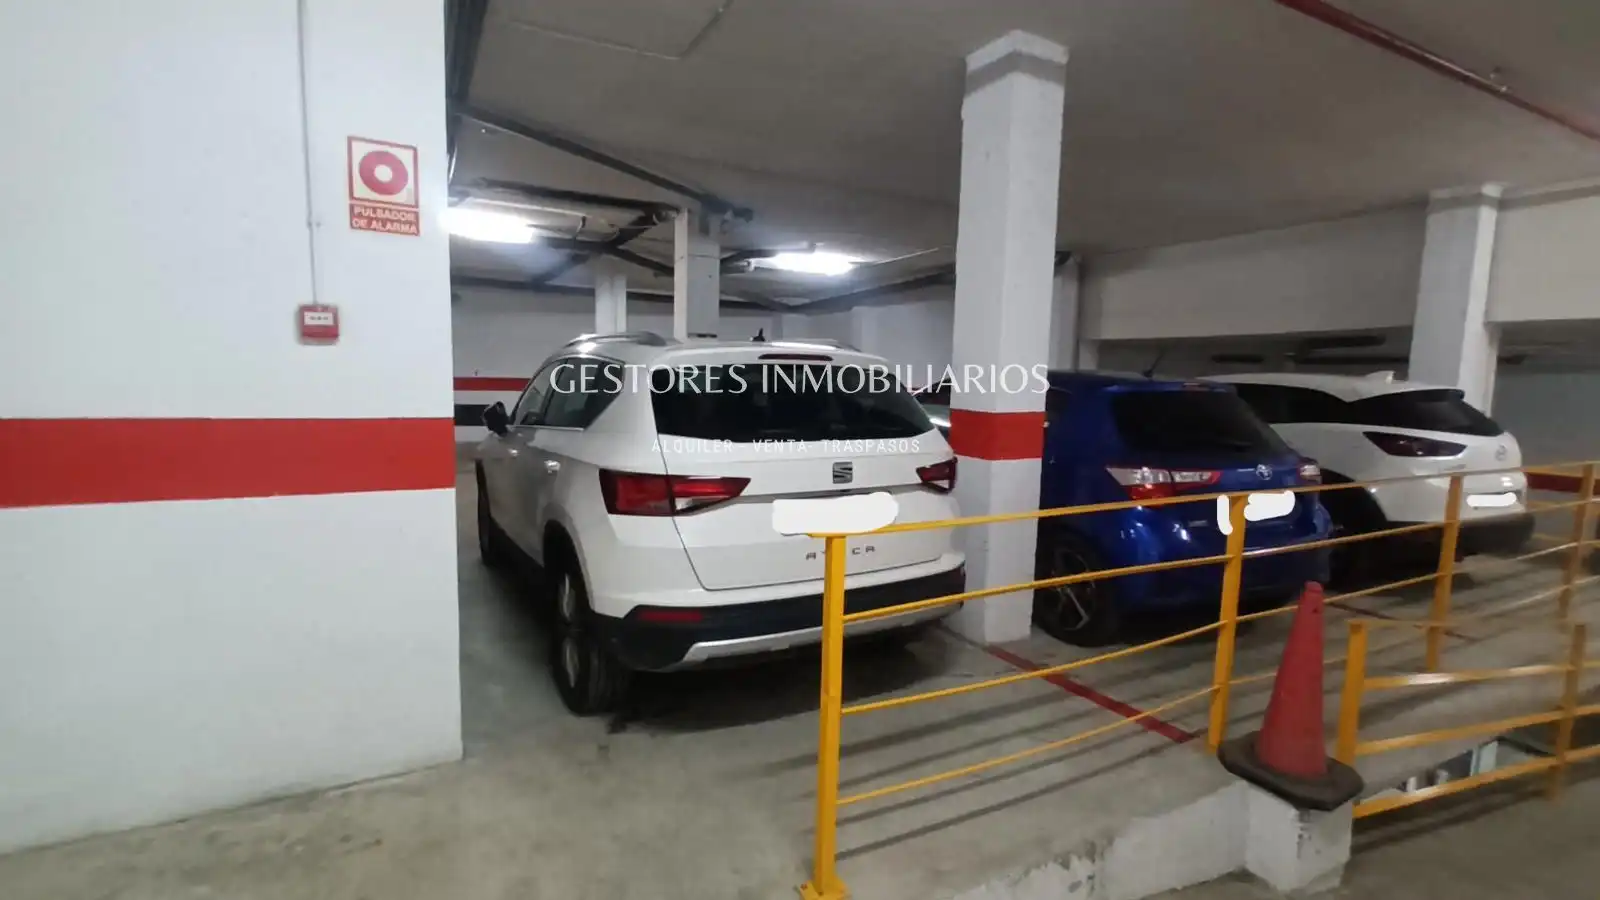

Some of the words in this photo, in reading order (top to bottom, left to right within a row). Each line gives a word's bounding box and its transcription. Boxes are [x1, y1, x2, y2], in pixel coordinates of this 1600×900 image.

[354, 205, 416, 220] PULSADOR
[352, 218, 368, 228] DE
[370, 219, 418, 233] ALARMA
[805, 545, 876, 560] ACA
